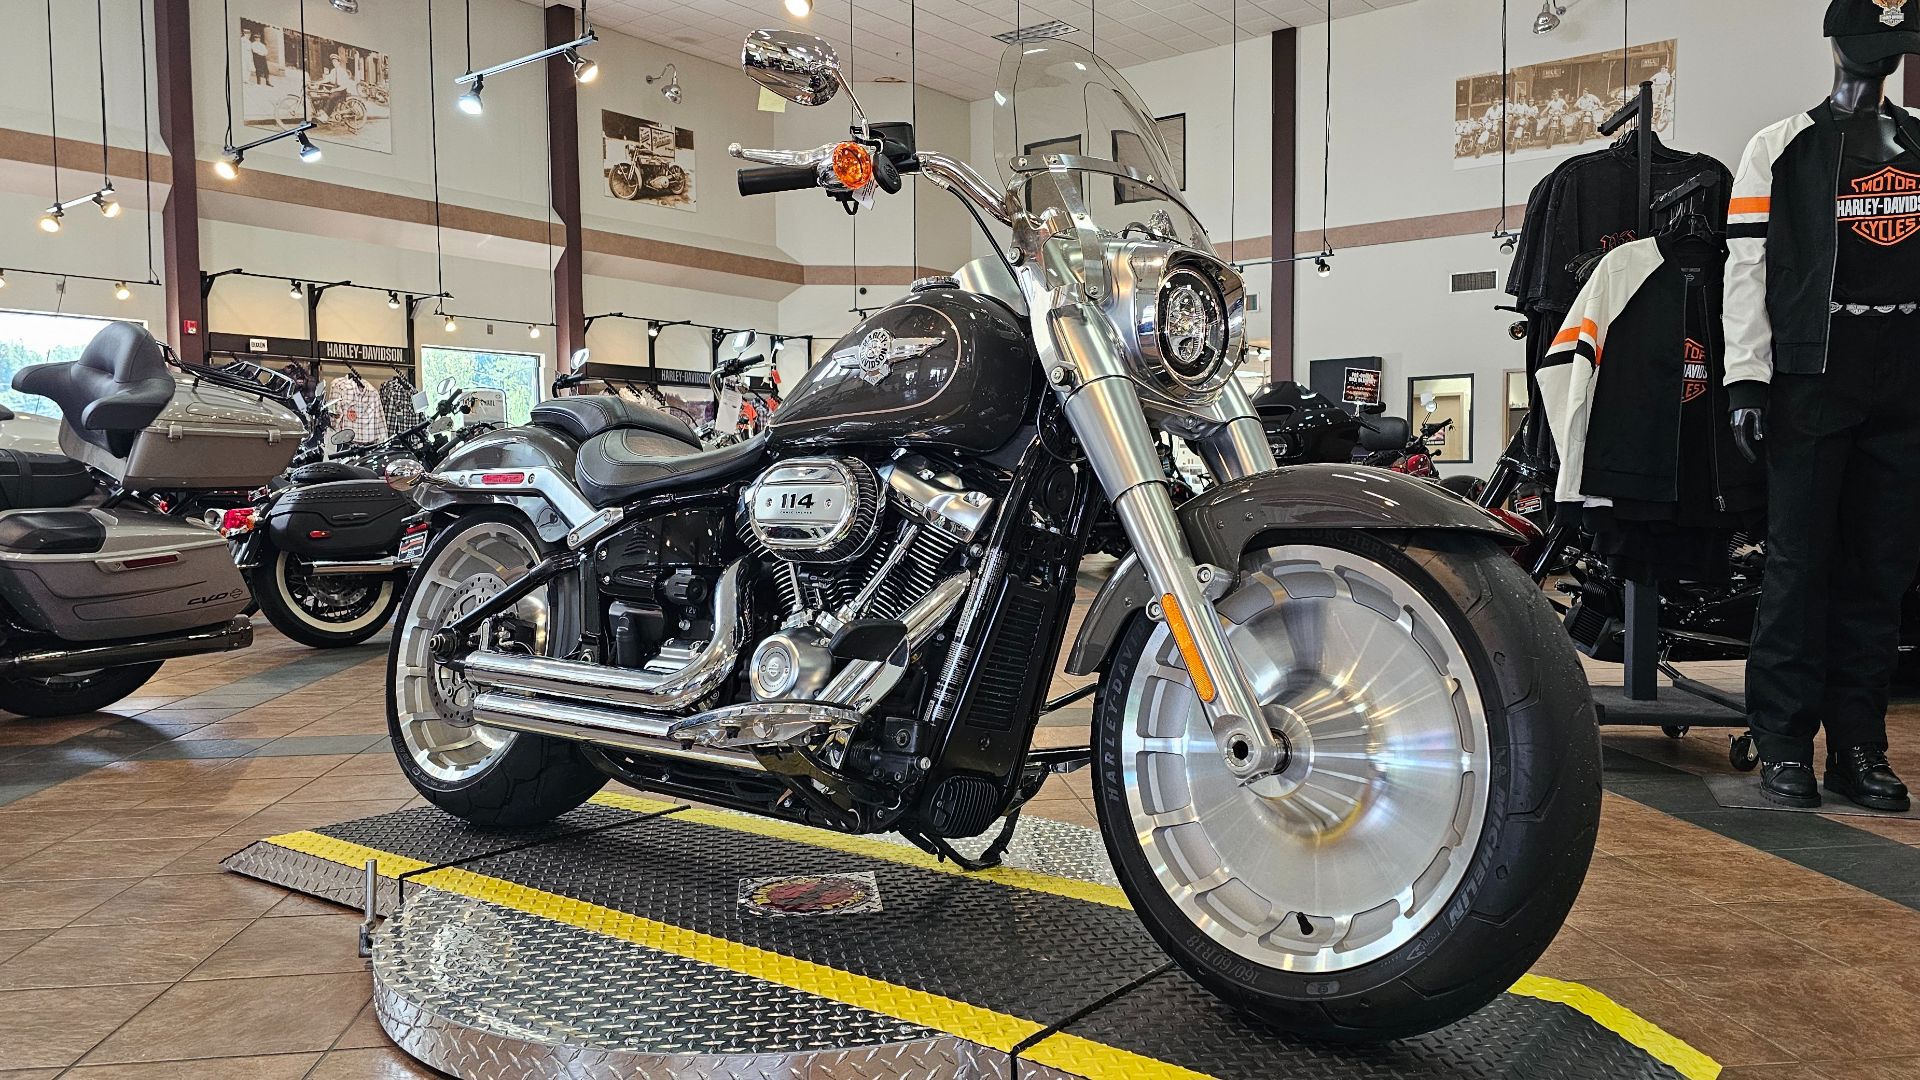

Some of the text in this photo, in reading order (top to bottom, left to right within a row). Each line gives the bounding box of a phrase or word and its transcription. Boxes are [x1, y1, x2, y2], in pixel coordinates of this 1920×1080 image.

[1861, 172, 1917, 193] MOTOR
[1861, 218, 1917, 241] CYCLES
[326, 342, 403, 362] HARLEY-DAVIDSON
[781, 493, 815, 509] 114
[1449, 785, 1506, 926] MICHELIN
